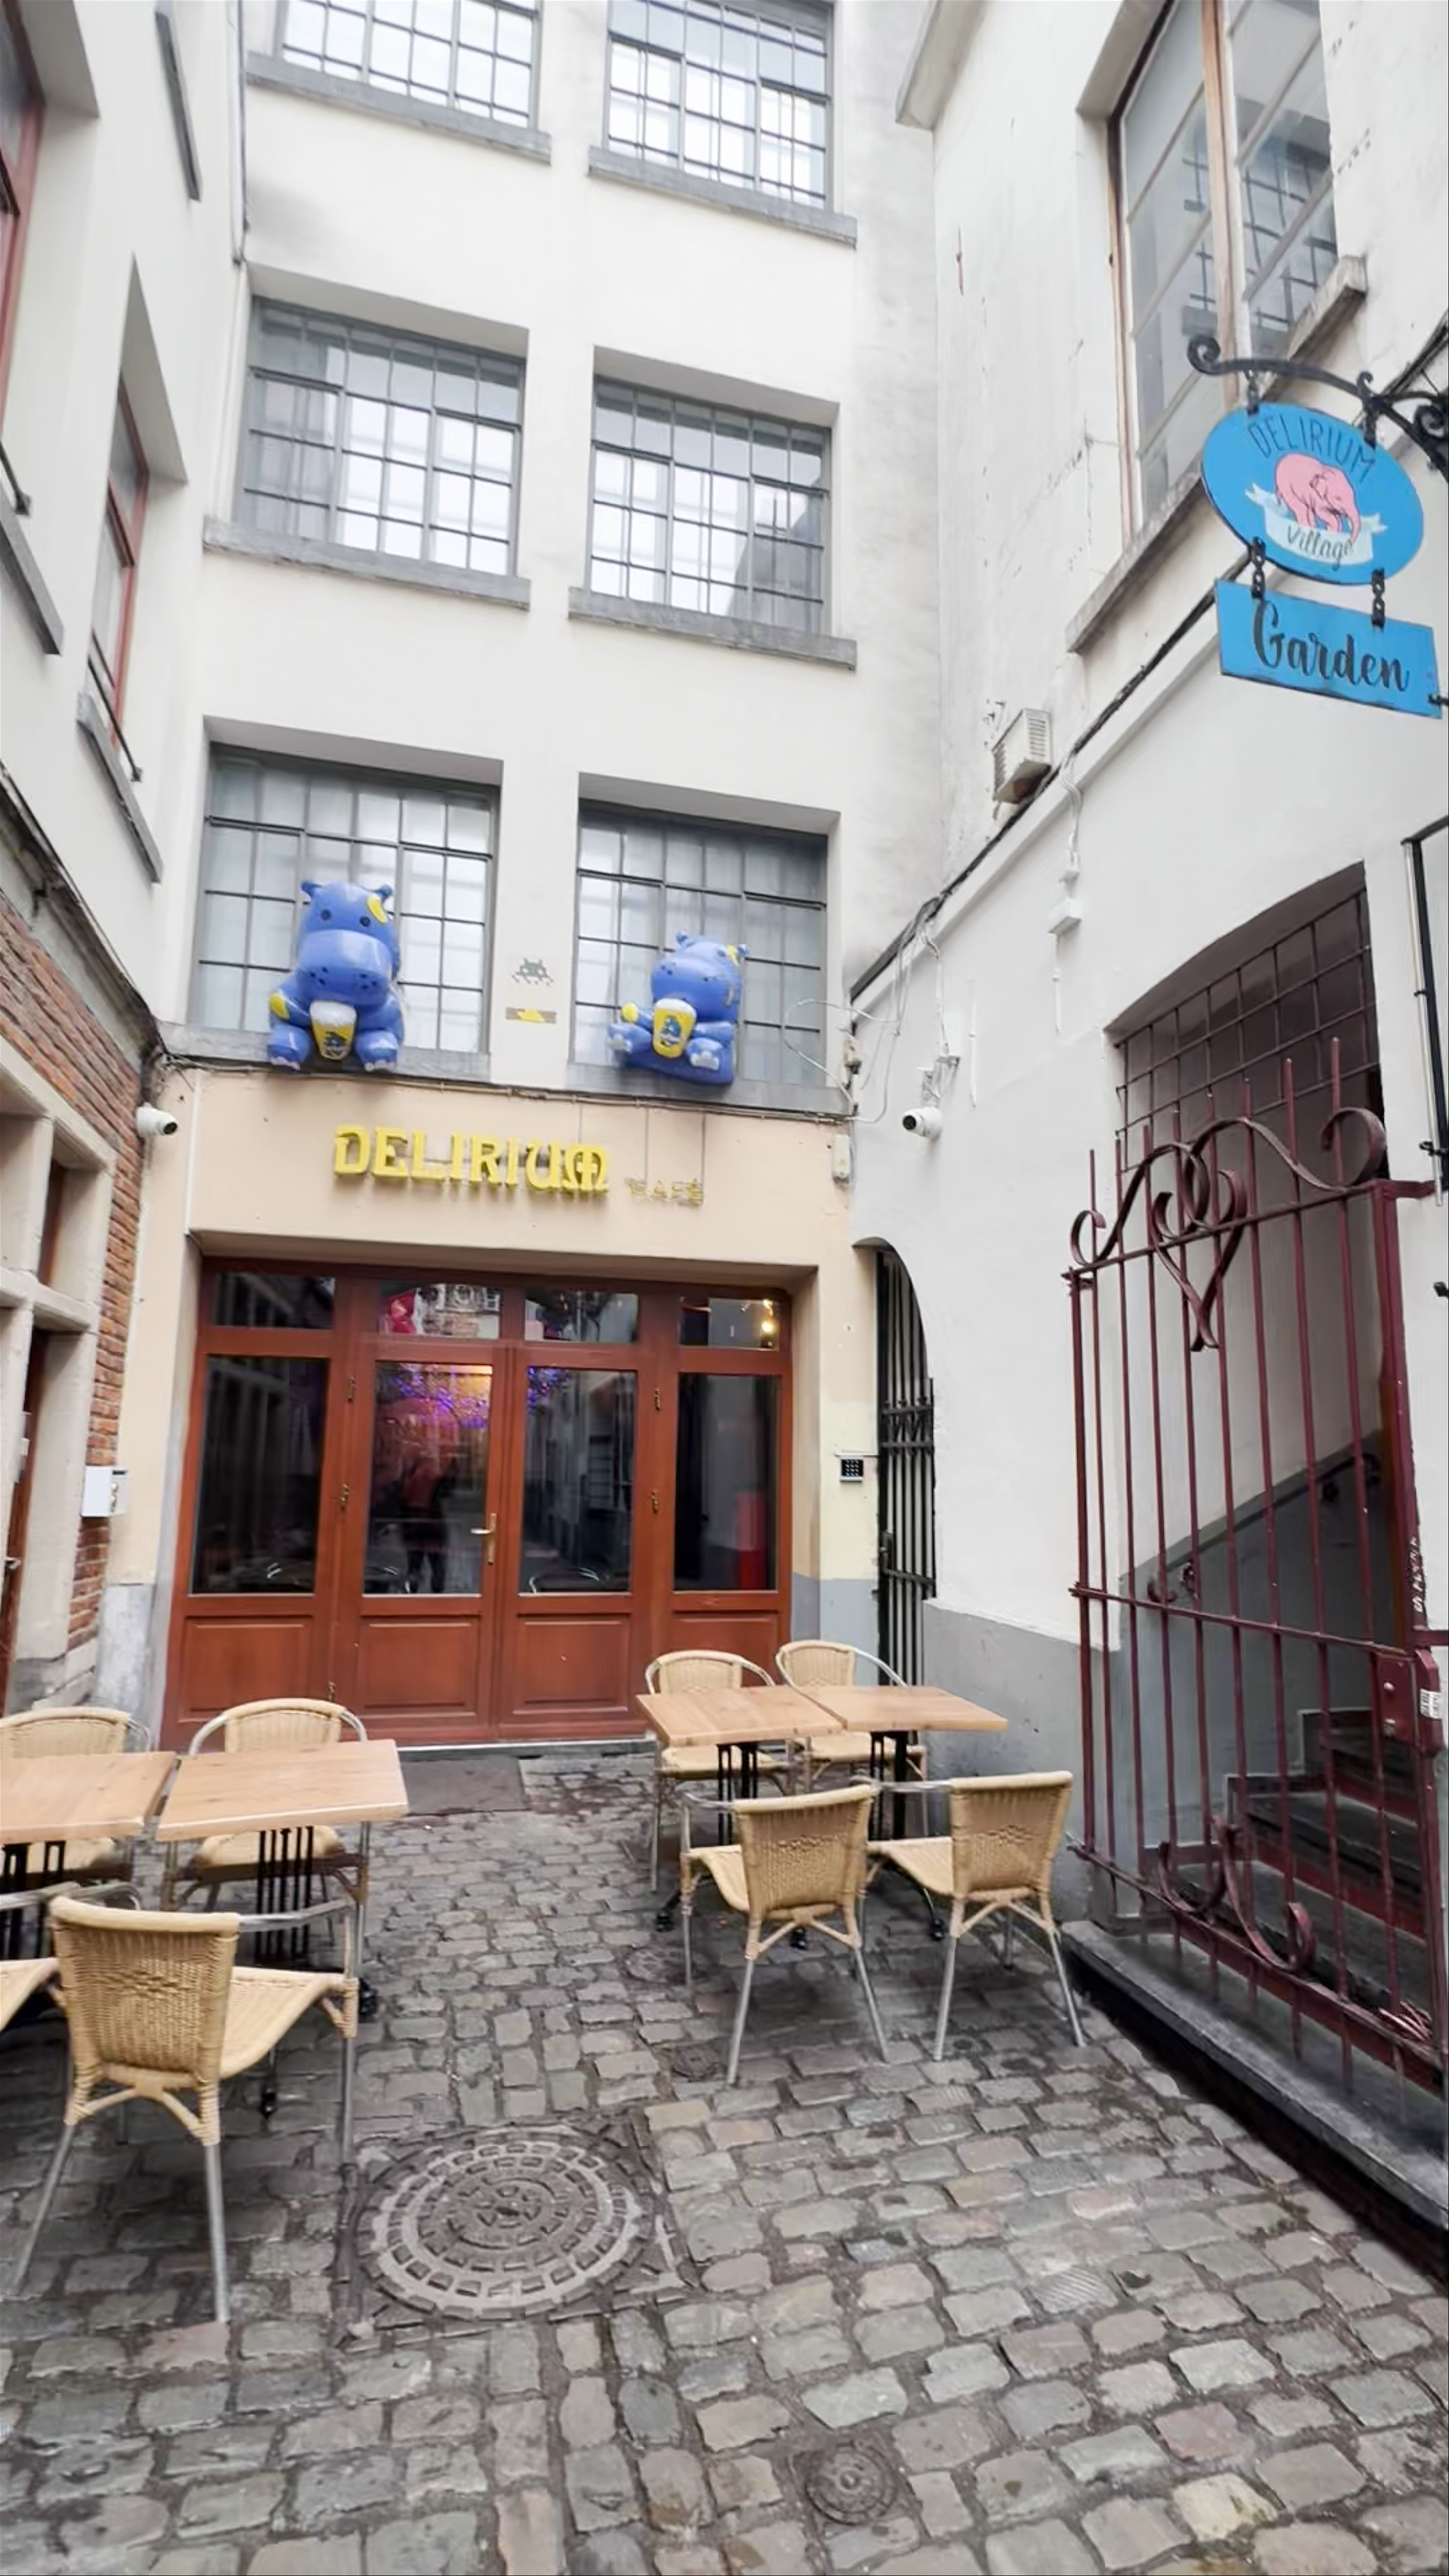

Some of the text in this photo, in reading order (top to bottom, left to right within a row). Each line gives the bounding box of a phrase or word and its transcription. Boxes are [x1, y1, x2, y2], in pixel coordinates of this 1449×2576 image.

[1247, 415, 1376, 484] DELIRIUM
[1253, 601, 1411, 691] Garden
[334, 1125, 609, 1195] DELIRIUM
